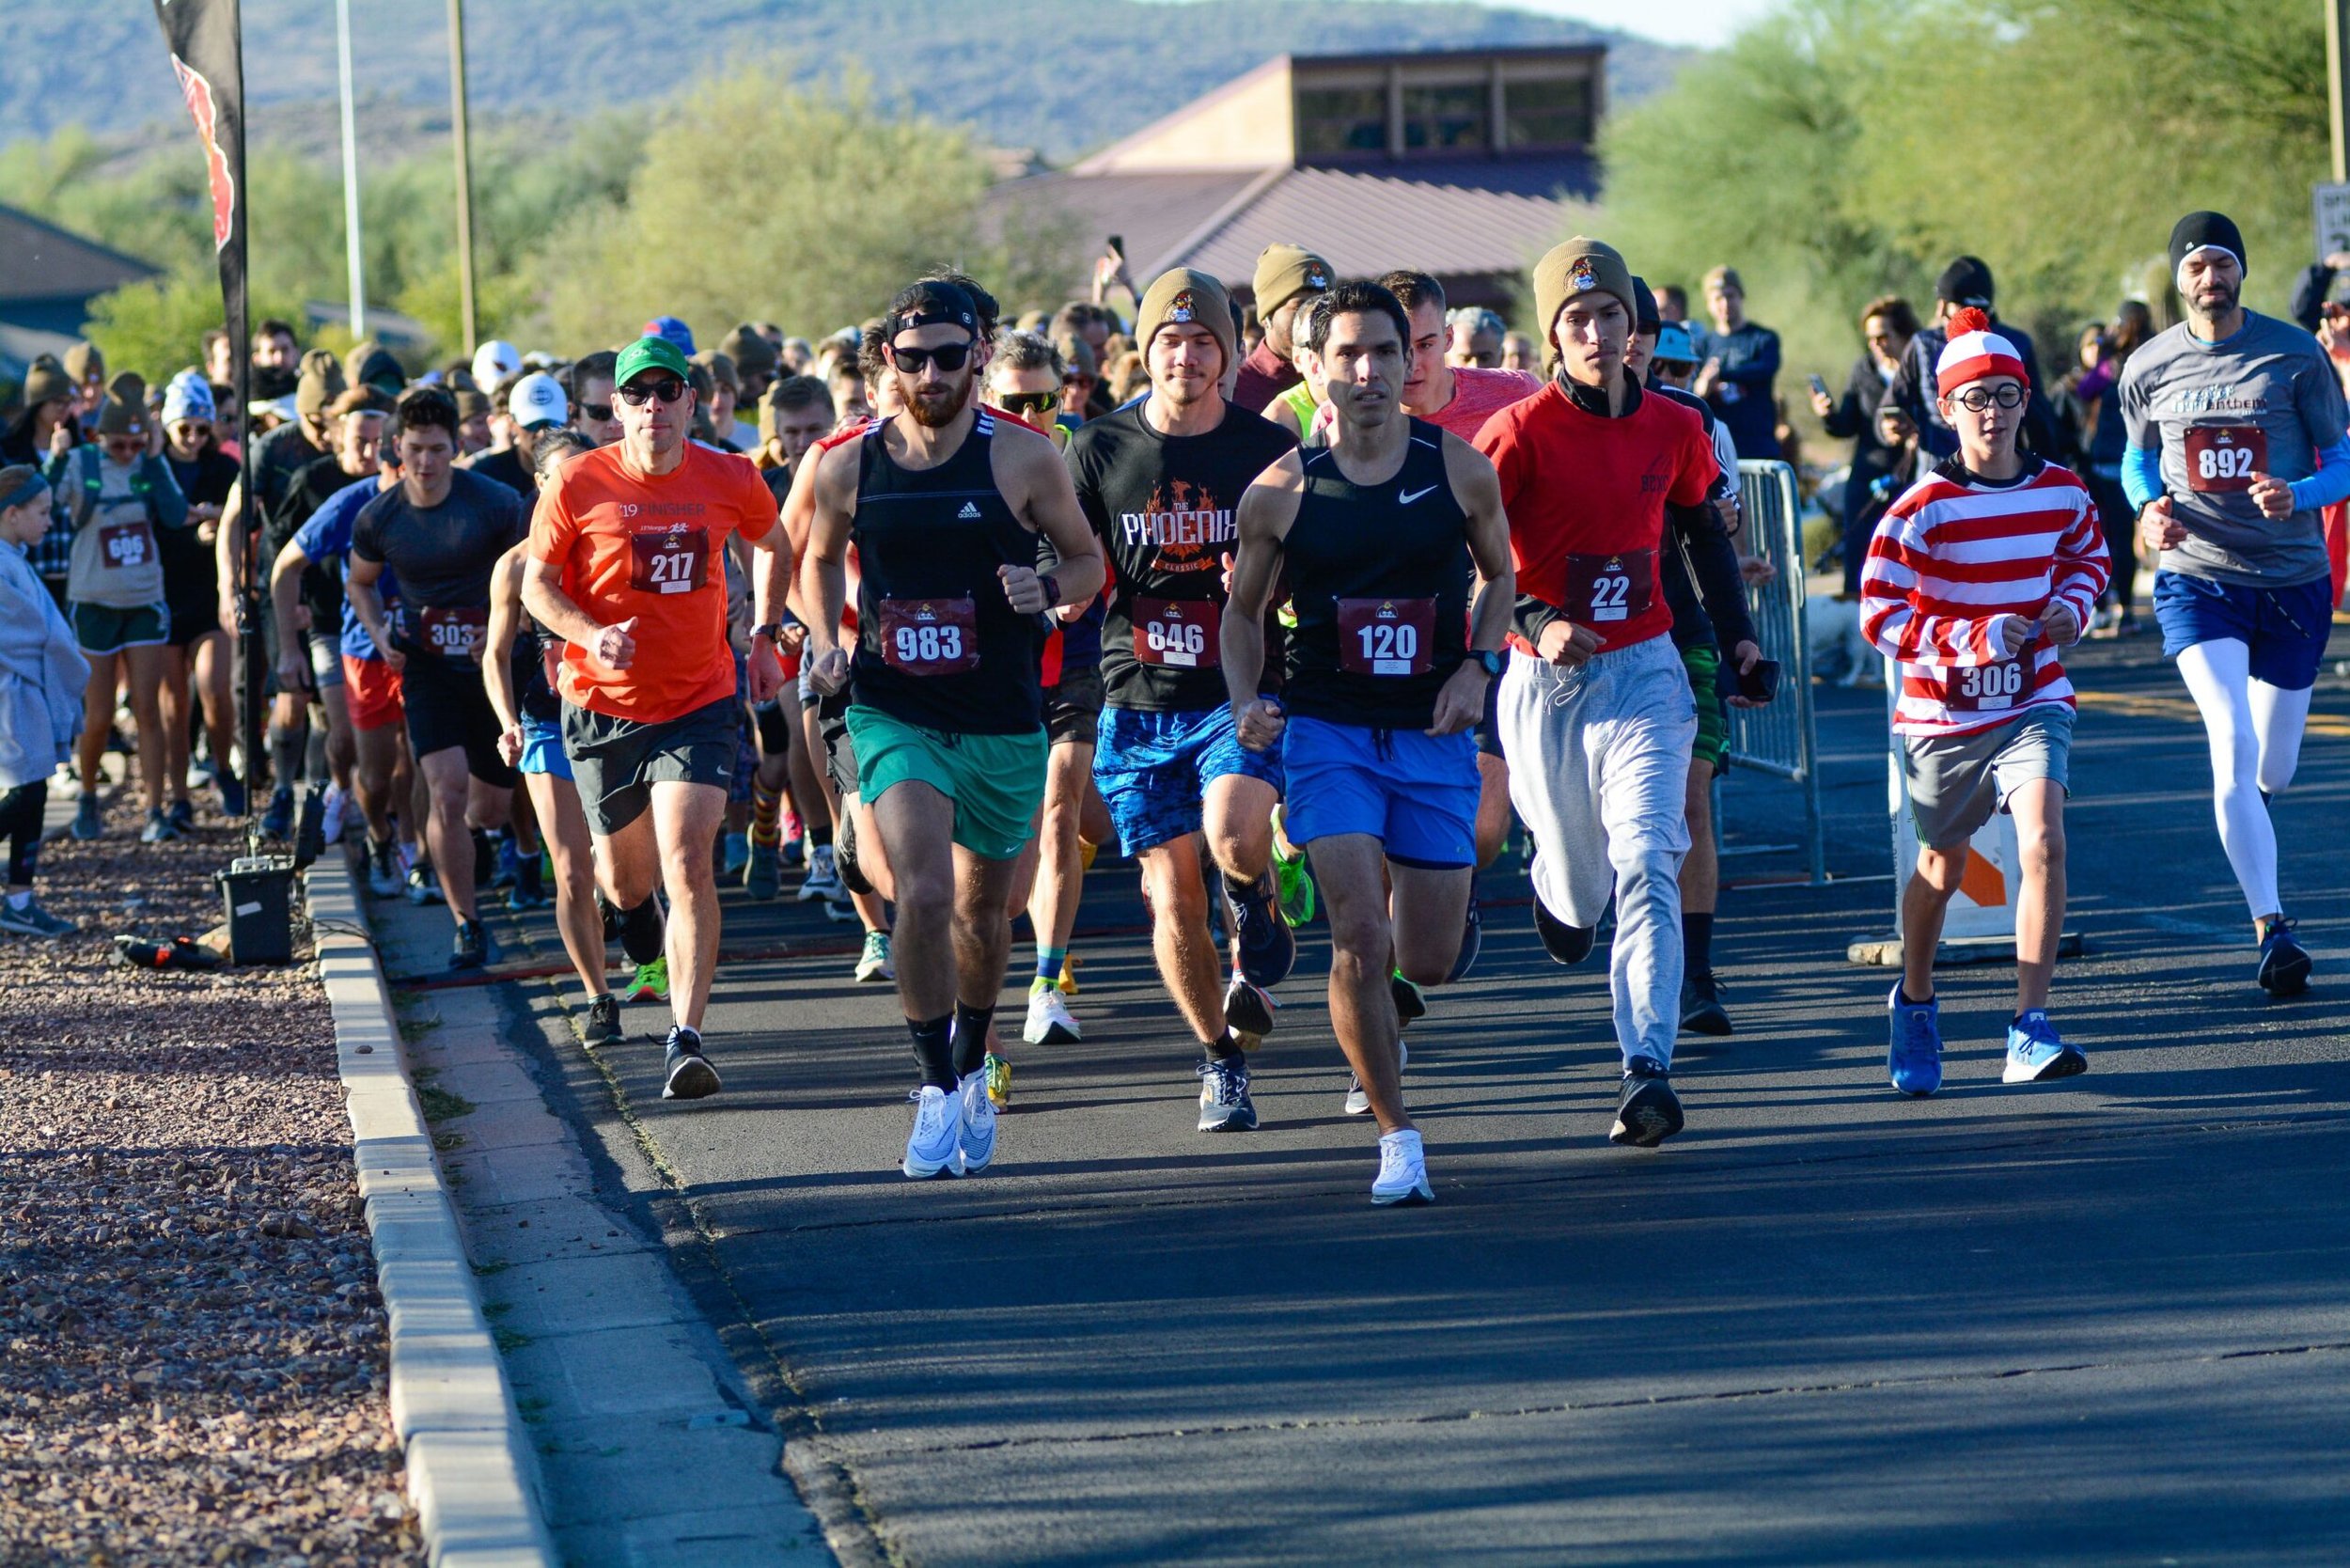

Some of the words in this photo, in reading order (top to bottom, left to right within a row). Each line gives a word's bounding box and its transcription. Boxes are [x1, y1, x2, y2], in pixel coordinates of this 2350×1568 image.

[2198, 447, 2253, 478] 892
[639, 502, 706, 516] FINISHER
[1173, 502, 1189, 511] THE
[650, 552, 694, 582] 217
[1165, 564, 1199, 572] CLASSIC
[1590, 575, 1630, 608] 22
[896, 625, 962, 661] 983
[1148, 620, 1204, 654] 846
[1357, 624, 1417, 659] 120
[1962, 662, 2022, 697] 306
